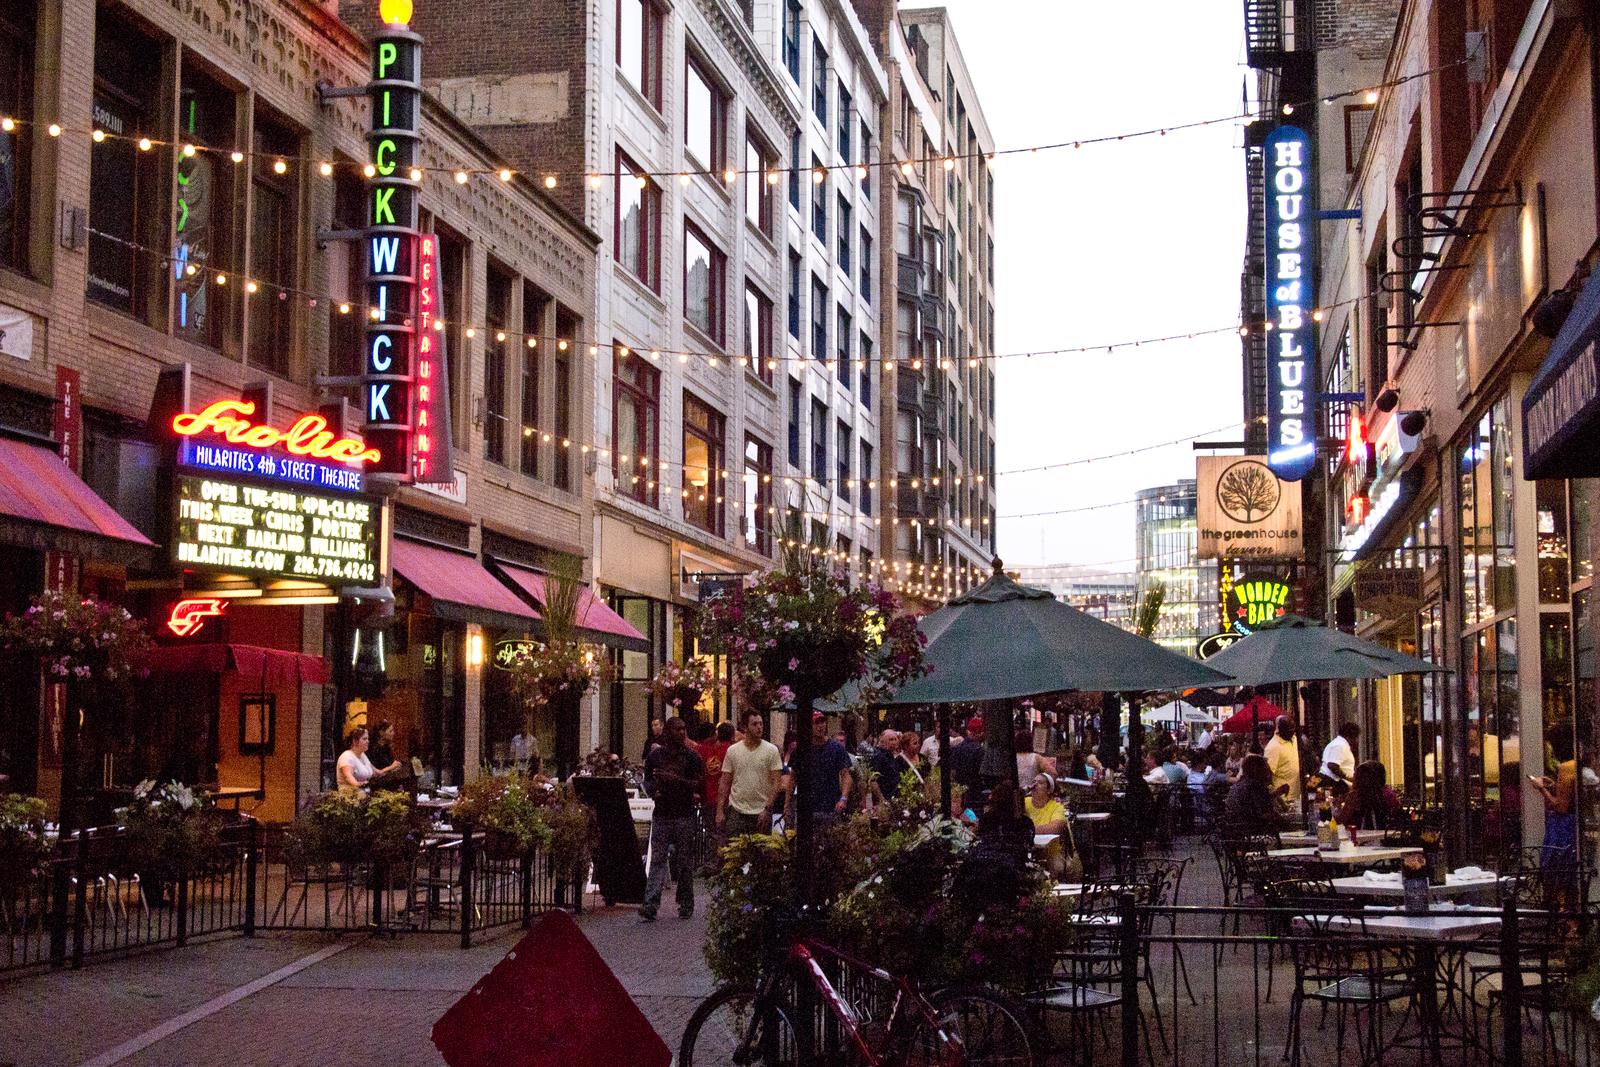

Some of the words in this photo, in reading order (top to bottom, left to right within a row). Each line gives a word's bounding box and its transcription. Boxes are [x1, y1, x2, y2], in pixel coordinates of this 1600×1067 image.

[1275, 141, 1303, 279] HOUSE
[371, 43, 400, 421] PICKWICK
[417, 239, 432, 476] RESTAURANT
[1277, 304, 1305, 446] BLUES
[172, 400, 382, 464] Frolic
[196, 446, 254, 473] HILARITIES
[257, 456, 276, 475] 4th
[280, 458, 317, 482] STREET
[320, 465, 361, 491] THEATRE
[201, 480, 238, 504] OPEN
[179, 499, 214, 522] THIS
[219, 505, 254, 527] WEEK
[265, 510, 305, 533] CHRIS
[312, 516, 363, 541] PORTER
[197, 522, 235, 545] NEXT
[245, 528, 306, 553] HARLAND
[310, 536, 367, 561] WILLIAMS
[178, 541, 286, 572] HILARITIES.COM
[1234, 581, 1289, 606] WONDER
[1248, 602, 1275, 625] BAR
